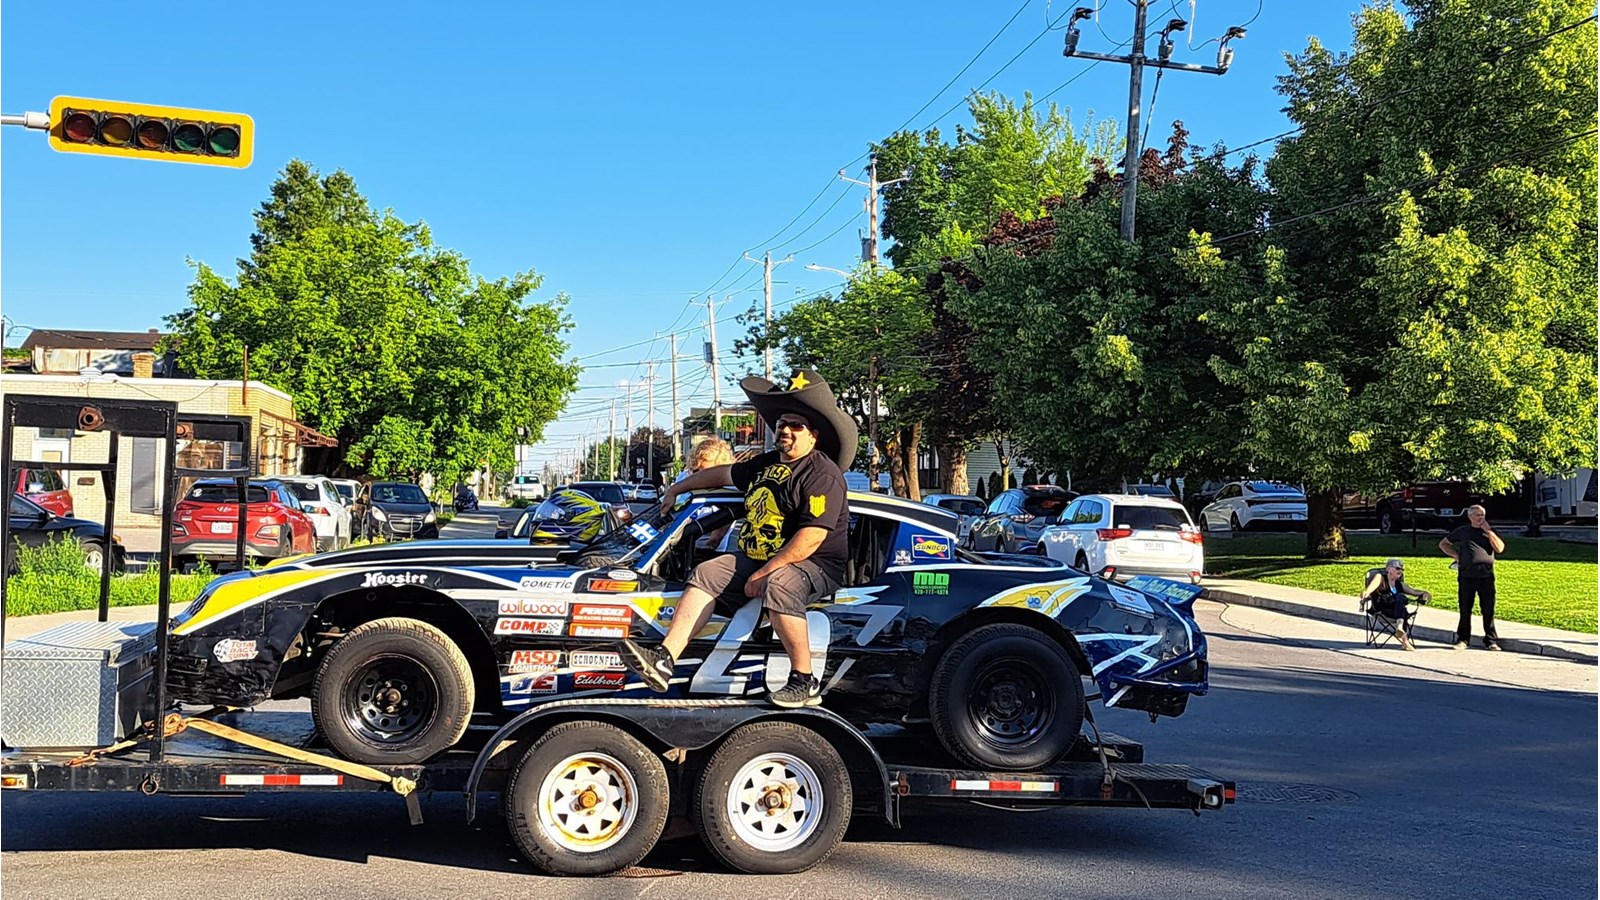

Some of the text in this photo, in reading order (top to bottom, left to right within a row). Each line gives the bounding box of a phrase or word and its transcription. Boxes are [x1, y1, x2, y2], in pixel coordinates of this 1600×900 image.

[360, 571, 428, 587] Hoosier
[500, 600, 567, 614] wilwood
[500, 620, 547, 631] COMP
[514, 651, 557, 664] MSD
[573, 655, 624, 665] SCHOENFEL
[514, 664, 553, 672] IGNITION
[575, 674, 623, 686] Edelbrock
